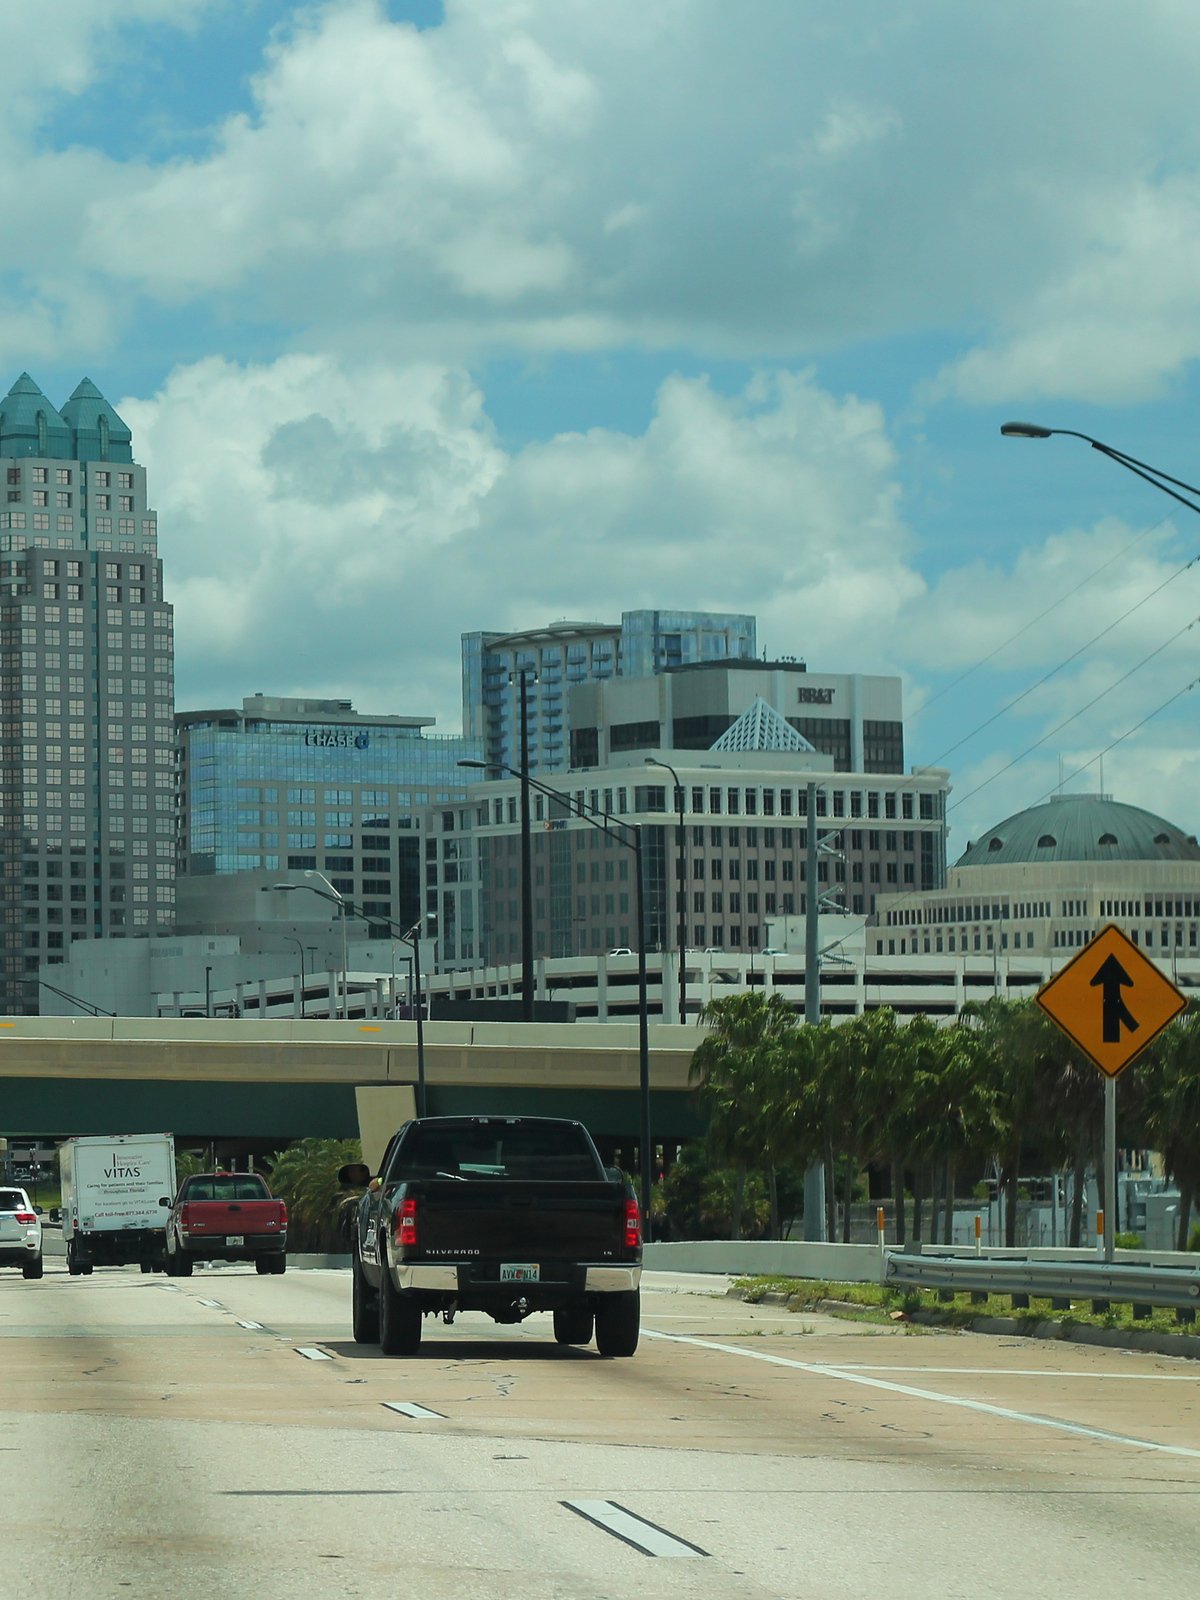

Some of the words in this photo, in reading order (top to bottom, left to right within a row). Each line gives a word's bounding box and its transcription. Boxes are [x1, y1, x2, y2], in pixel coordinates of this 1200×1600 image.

[797, 687, 835, 704] BB&T
[304, 733, 356, 747] CHASE
[104, 1167, 140, 1178] VITAS
